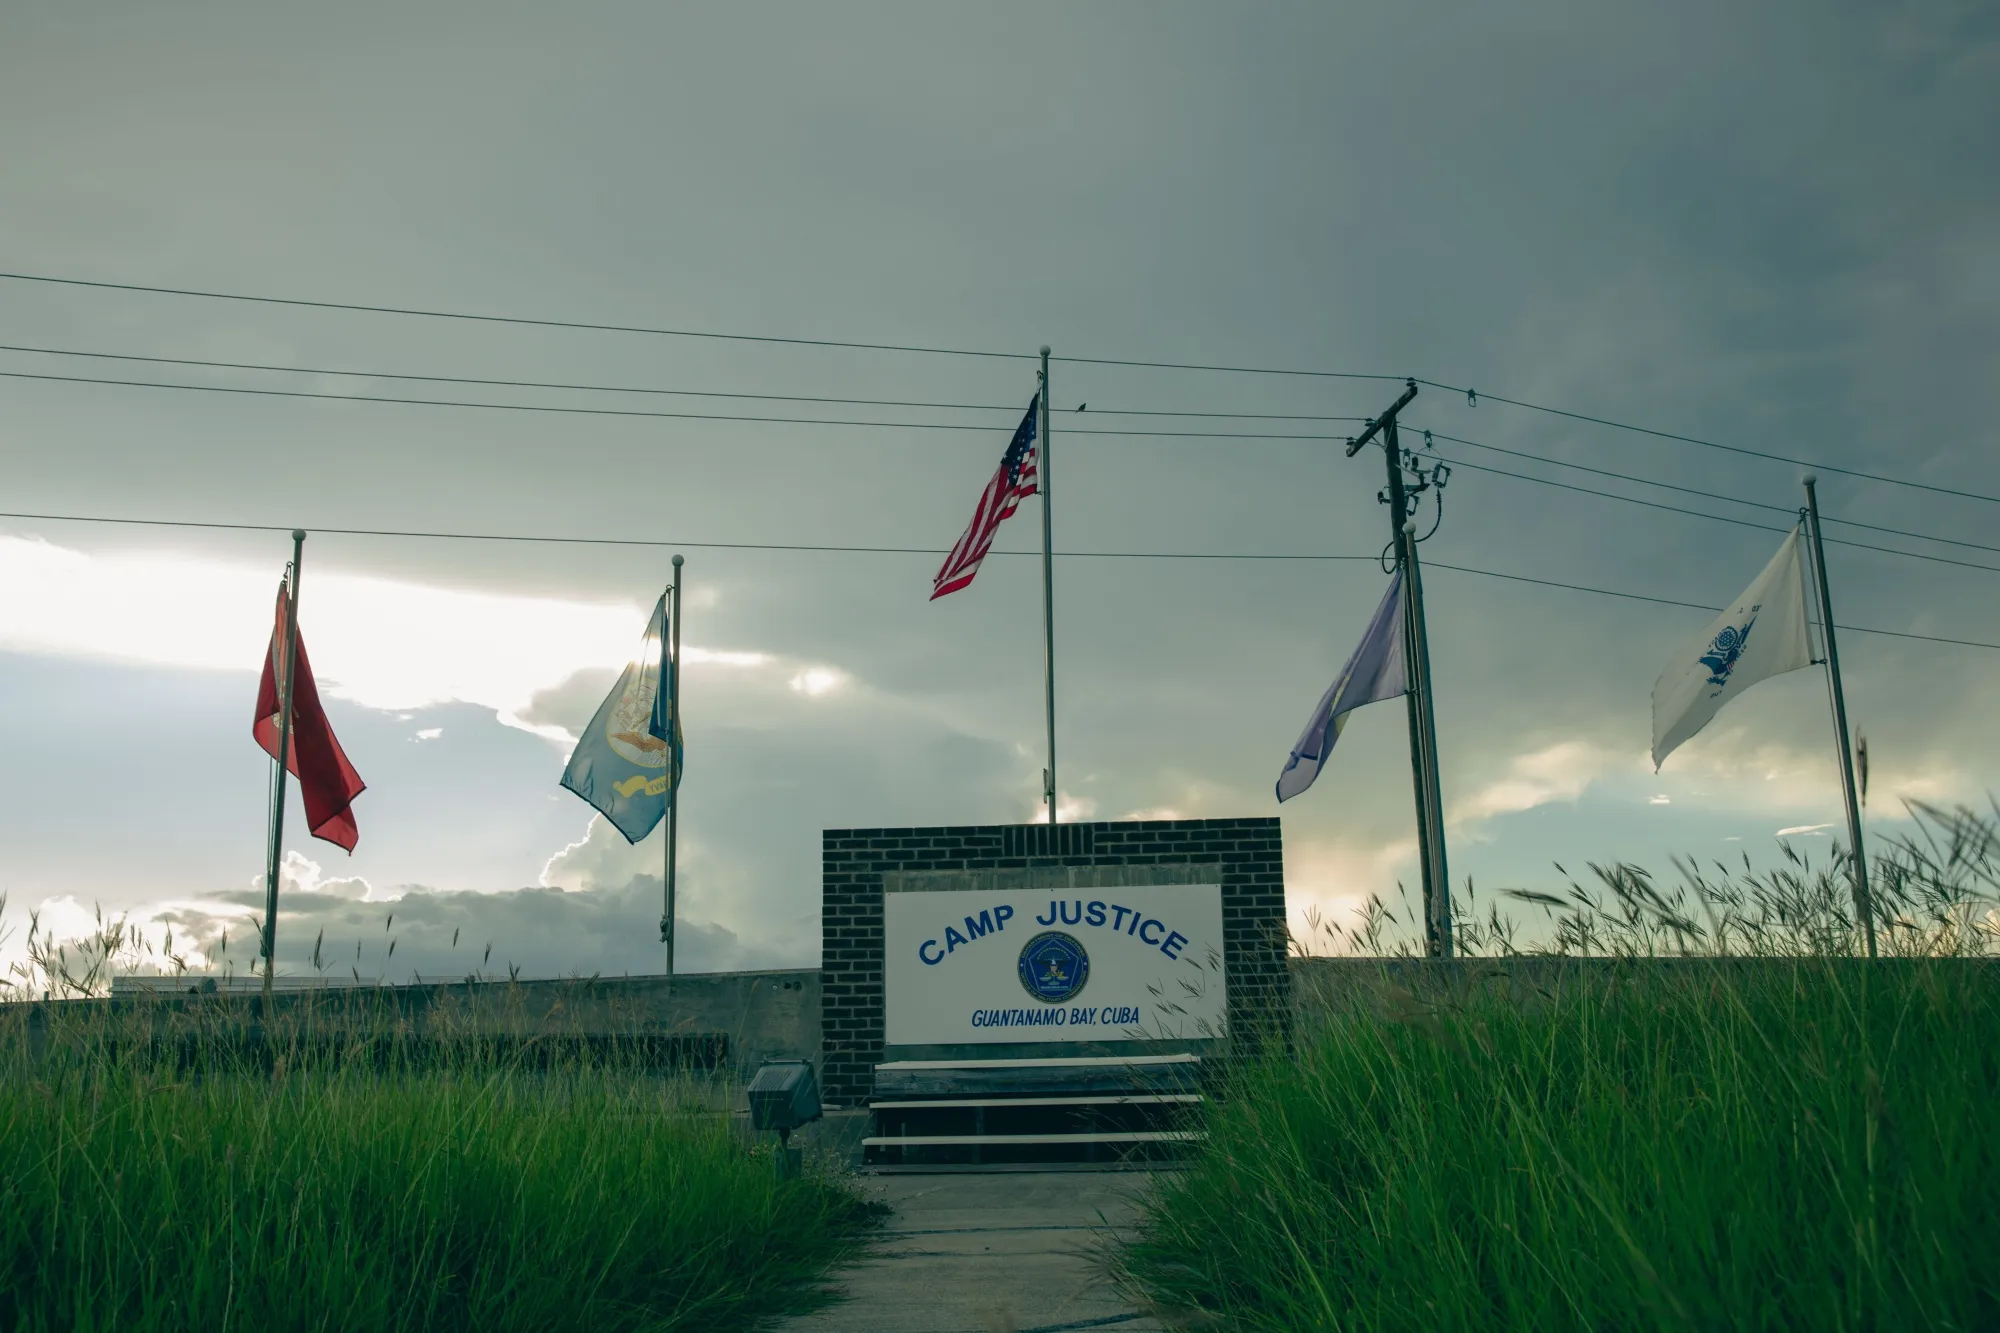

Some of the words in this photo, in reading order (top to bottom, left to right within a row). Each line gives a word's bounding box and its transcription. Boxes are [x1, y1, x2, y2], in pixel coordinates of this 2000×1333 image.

[919, 905, 1014, 966] CAMP
[1036, 901, 1189, 961] JUSTICE
[972, 1008, 1066, 1027] GUANTANAMO
[1070, 1008, 1097, 1026] BAY,
[1101, 1007, 1139, 1025] CUBA
